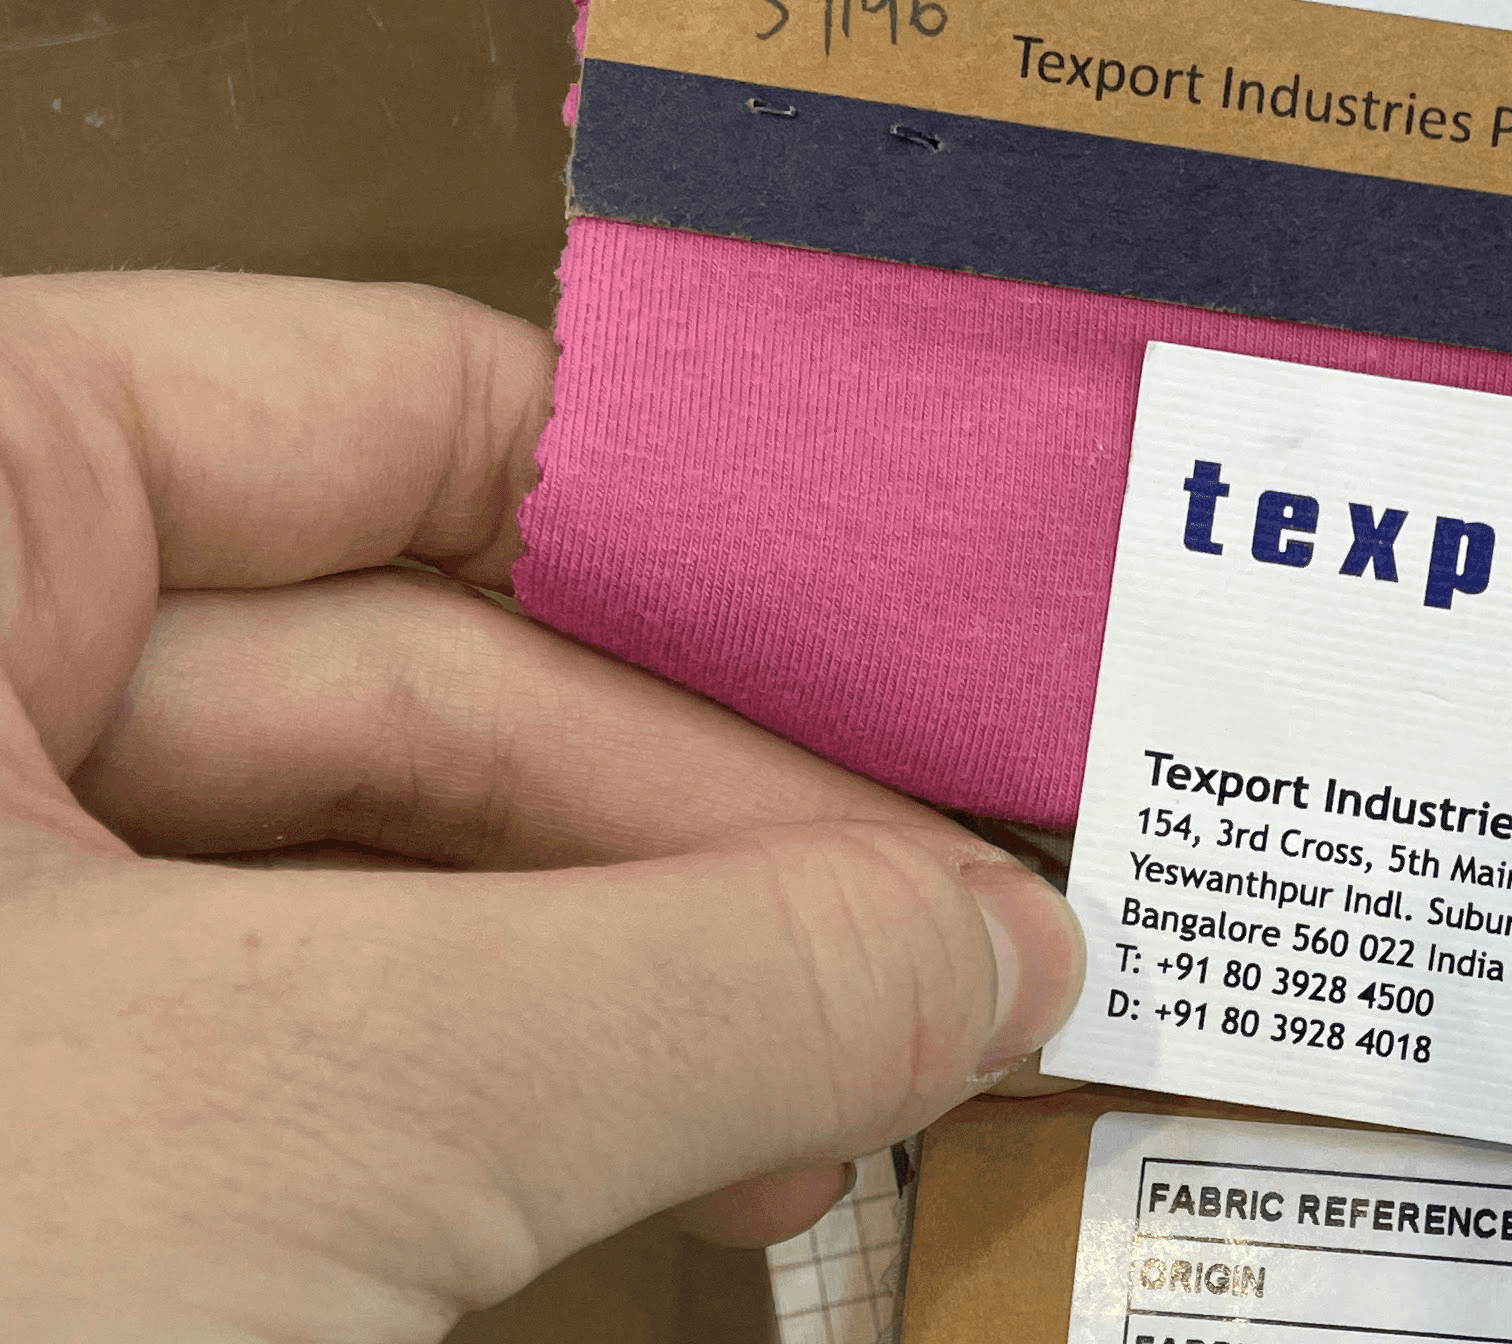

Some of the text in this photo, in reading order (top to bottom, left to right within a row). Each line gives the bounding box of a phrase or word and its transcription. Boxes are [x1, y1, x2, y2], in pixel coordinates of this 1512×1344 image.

[1013, 35, 1204, 104] Texport
[1222, 67, 1471, 143] Industries
[1145, 750, 1309, 809] Texport
[1139, 808, 1200, 848] 154,
[1217, 819, 1269, 852] 3rd
[1281, 829, 1372, 873] Cross,
[1389, 844, 1439, 878] 5th
[1130, 851, 1334, 908] Yeswanthpur
[1344, 885, 1412, 921] Indl.
[1122, 897, 1503, 982] Bangalore 560 022 India
[1116, 943, 1434, 1016] T: +91 80 3928 4500
[1108, 989, 1431, 1063] D: +91 80 3928 4018
[1149, 1183, 1284, 1221] FABRIC
[1141, 1258, 1266, 1298] ORIGIN
